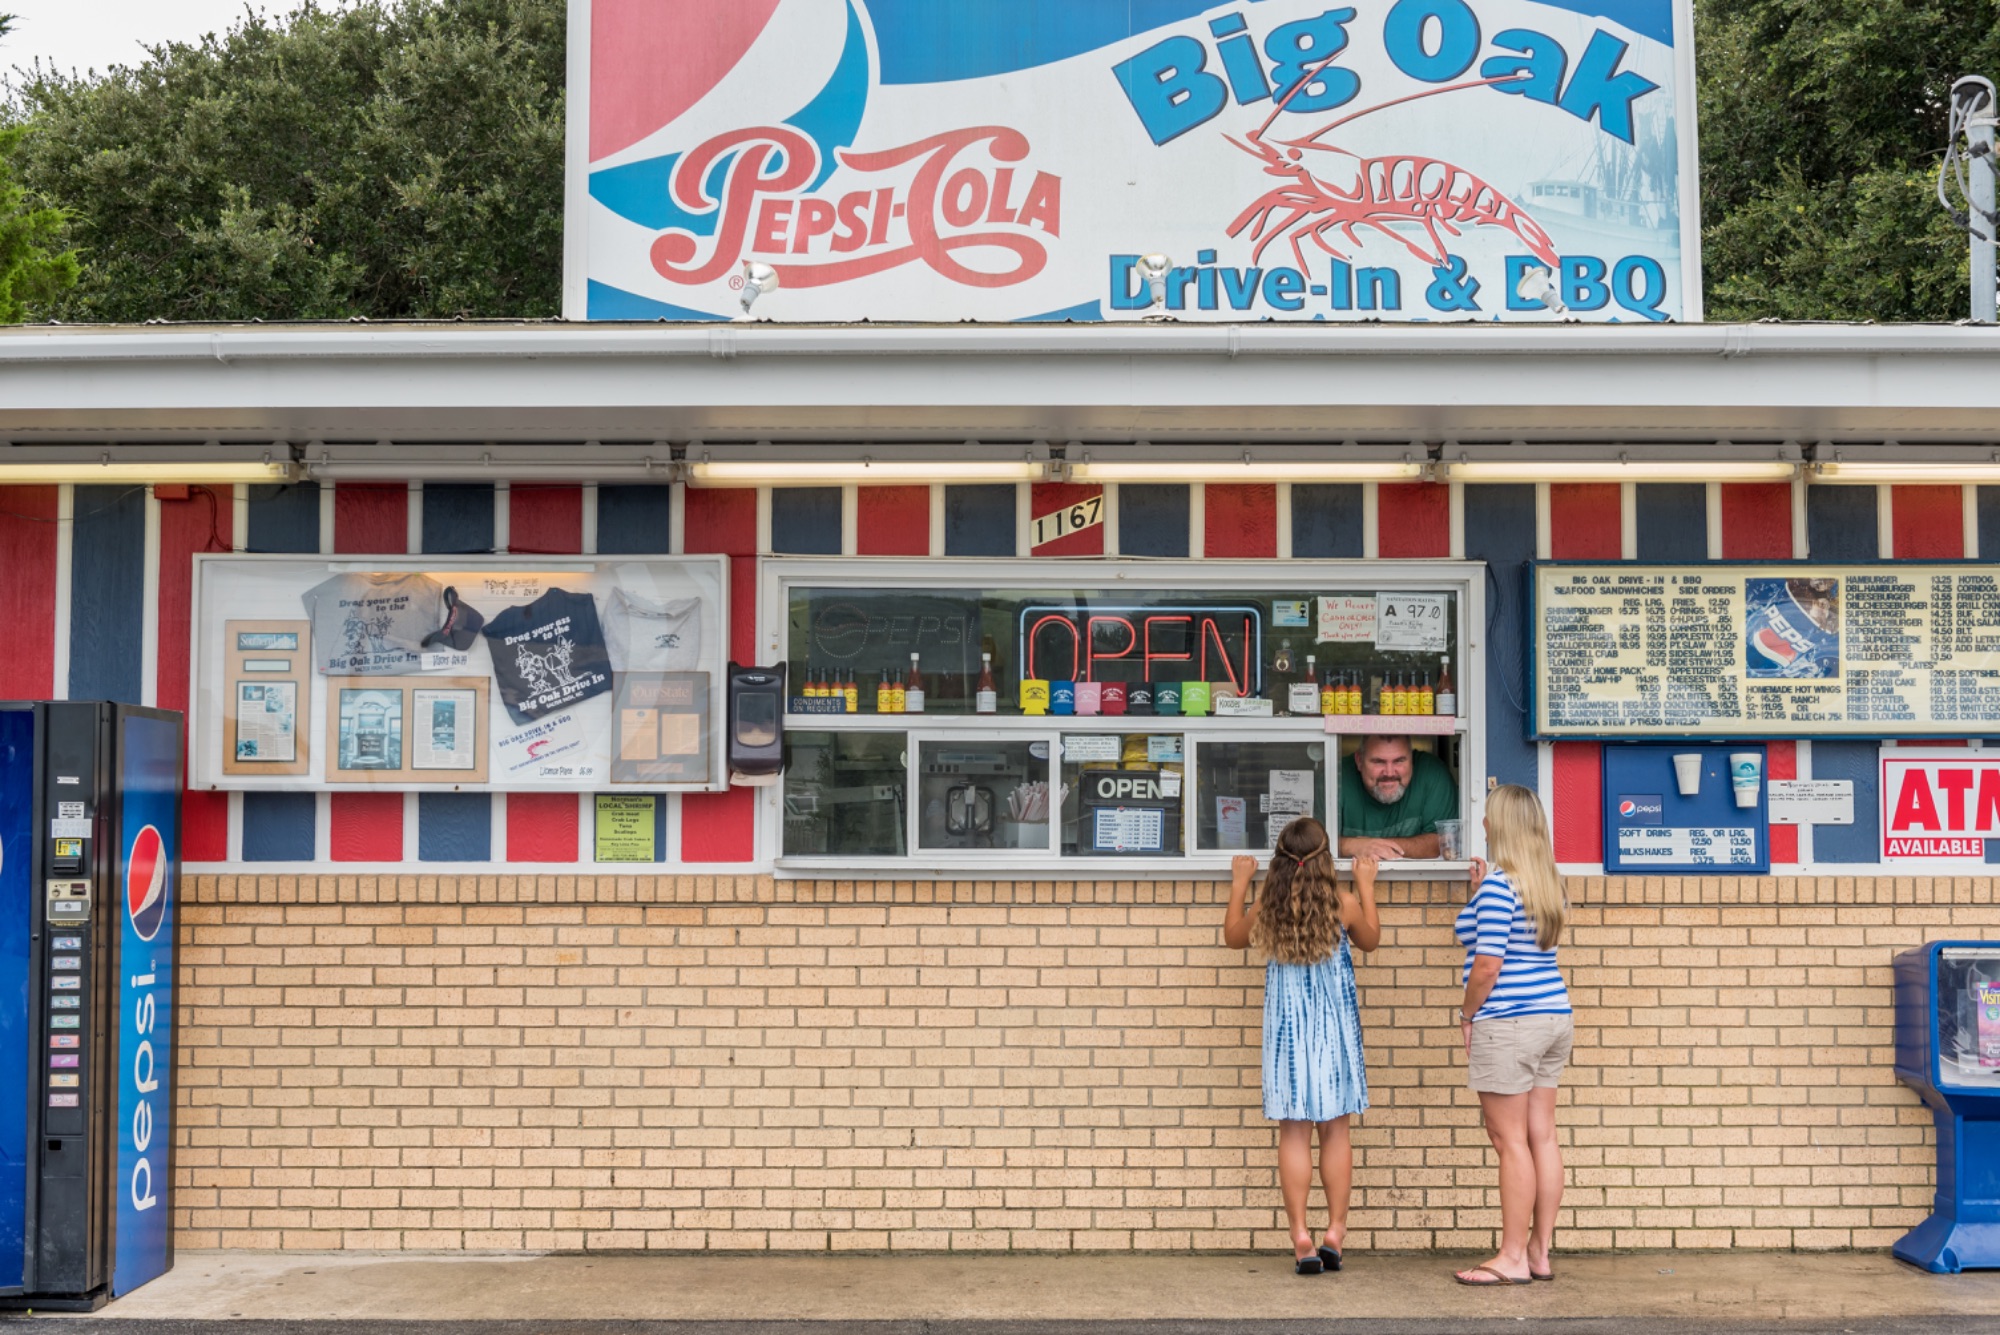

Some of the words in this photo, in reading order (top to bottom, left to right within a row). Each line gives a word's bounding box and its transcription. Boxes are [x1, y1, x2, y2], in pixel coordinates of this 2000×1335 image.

[1111, 7, 1361, 146] Big
[1384, 0, 1660, 146] Oak
[1109, 249, 1401, 312] Drive-In
[1425, 254, 1482, 311] &
[1505, 254, 1671, 321] BBQ
[1037, 497, 1101, 543] 1167
[1572, 576, 1587, 584] BIG
[1592, 576, 1611, 584] OAK
[1618, 576, 1644, 584] DRIVE
[1654, 576, 1664, 584] IN
[1671, 576, 1677, 584] &
[1683, 576, 1702, 584] BBQ
[1846, 576, 1898, 584] HAMBURGER
[1958, 576, 1994, 584] HOTDOG
[1554, 586, 1595, 595] SEAFOOD
[1679, 586, 1699, 595] SIDE
[1702, 586, 1736, 595] ORDERS
[339, 598, 363, 608] Drag
[366, 597, 390, 607] your
[393, 595, 409, 603] ass
[1846, 593, 1910, 601] CHEESEBURGER
[1957, 593, 1981, 601] FRIED
[1672, 598, 1696, 606] FRIES
[376, 604, 386, 612] to
[389, 603, 405, 611] the
[1385, 605, 1397, 617] A
[1546, 607, 1613, 615] SHRIMPBURGER
[504, 633, 531, 645] Drag
[532, 624, 554, 638] your
[556, 616, 571, 626] ass
[542, 632, 553, 641] to
[554, 624, 570, 635] the
[867, 616, 975, 644] PEPSI
[1546, 624, 1605, 632] CLAMBURGER
[1547, 641, 1617, 649] SCALLOPBURGER
[1029, 614, 1250, 697] OPEN
[1547, 650, 1593, 658] SOFTSHELL
[1595, 650, 1618, 658] CRAB
[330, 658, 347, 669] Big
[350, 656, 370, 666] Oak
[374, 654, 403, 665] Drive
[406, 652, 418, 662] In
[1548, 658, 1594, 666] FLOUNDER
[1593, 667, 1618, 675] HOME
[1846, 678, 1869, 686] FRIED
[1871, 678, 1892, 686] CRAB
[1895, 678, 1916, 686] CAKE
[518, 700, 537, 712] Big
[539, 691, 561, 704] Oak
[563, 681, 591, 696] Drive
[592, 673, 605, 684] In
[793, 698, 841, 706] CONDIMENTS
[1791, 695, 1819, 704] RANCH
[1846, 695, 1869, 703] FRIED
[1871, 695, 1904, 703] OYSTER
[793, 705, 804, 713] ON
[807, 705, 841, 713] REQUEST
[1846, 712, 1869, 720] FRIED
[1872, 712, 1916, 720] FLOUNDER
[1329, 717, 1364, 731] PLACE
[1372, 717, 1415, 731] ORDERS
[1423, 717, 1451, 732] HERE
[1602, 718, 1625, 726] STEW
[1097, 777, 1163, 799] OPEN
[1636, 804, 1662, 813] pepsi
[53, 828, 89, 837] CANS
[1619, 829, 1641, 837] SOFT
[1646, 829, 1672, 837] DRINS
[1689, 829, 1708, 837] REG.
[1713, 829, 1725, 837] OR
[1888, 840, 1979, 854] AVAILABLE
[1690, 848, 1706, 856] REG
[131, 973, 158, 1211] pepsi
